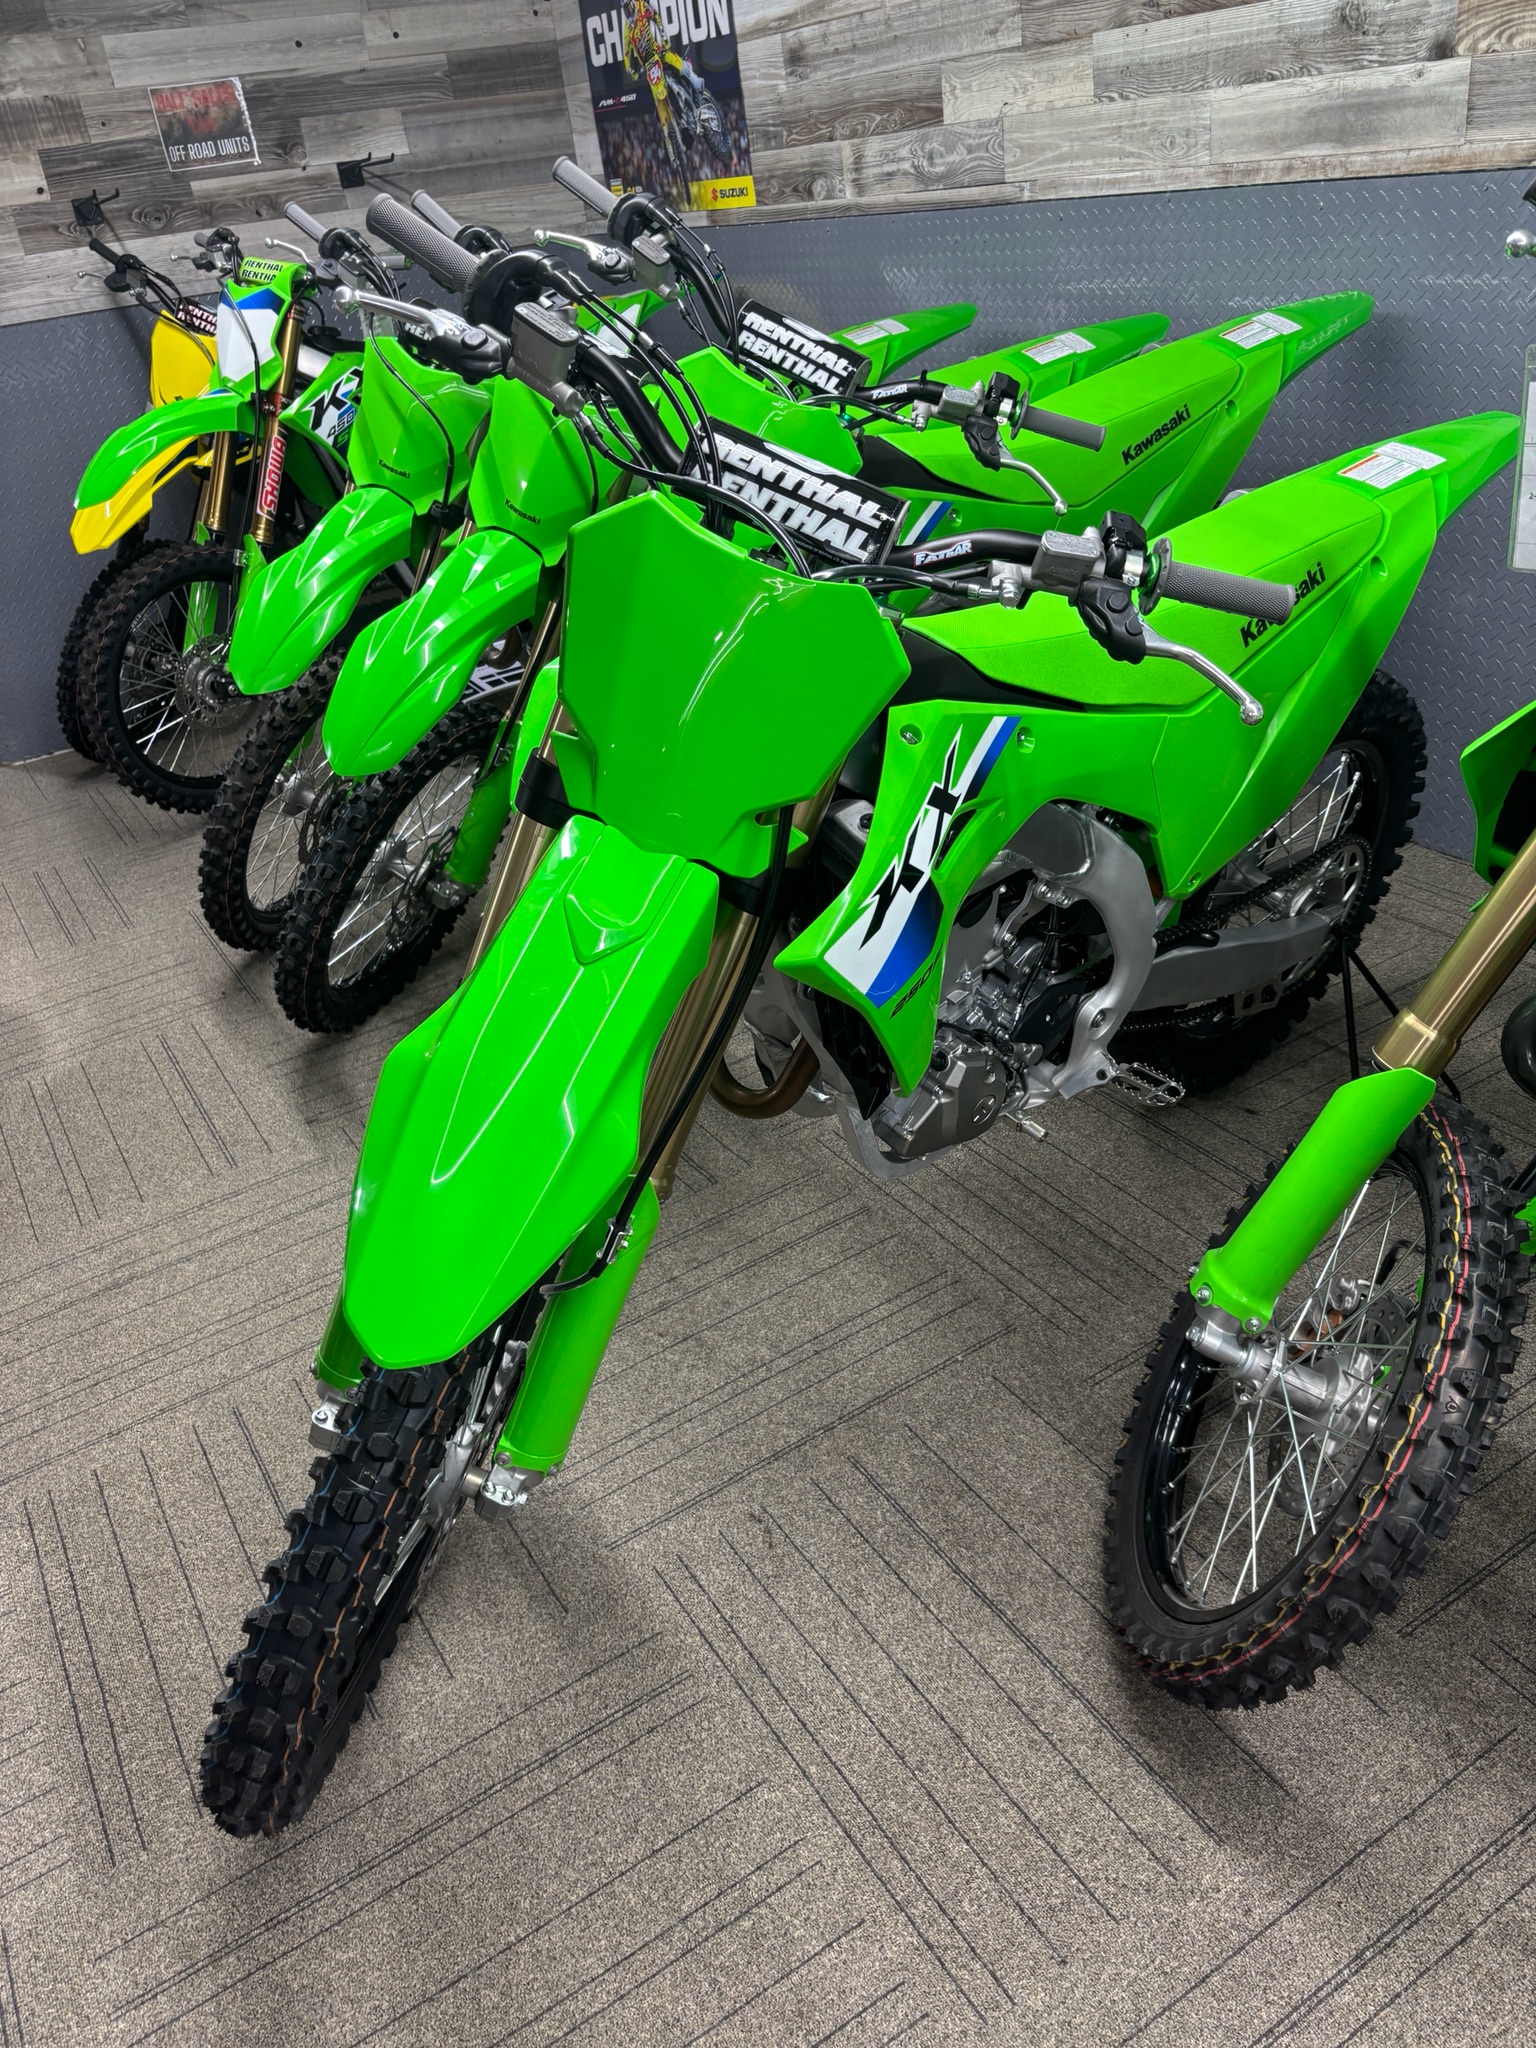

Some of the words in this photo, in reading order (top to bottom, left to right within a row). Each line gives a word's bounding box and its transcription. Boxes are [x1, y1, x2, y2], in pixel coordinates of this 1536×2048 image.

[586, 0, 731, 67] CHPION
[168, 145, 186, 162] OFF
[187, 141, 216, 160] ROAD
[217, 136, 250, 156] UNITS
[719, 187, 749, 199] SUZUKI
[738, 329, 841, 395] RENTHAL
[742, 311, 852, 378] RENTHAL
[326, 411, 355, 440] 450
[1121, 403, 1192, 467] Kawasaki
[261, 434, 287, 515] SHOWA
[378, 458, 411, 479] Kawasaki
[699, 432, 883, 530] RENTHAL
[504, 499, 541, 525] Kawasaki
[913, 540, 973, 567] FATBAR
[1239, 560, 1327, 649] Kaaki
